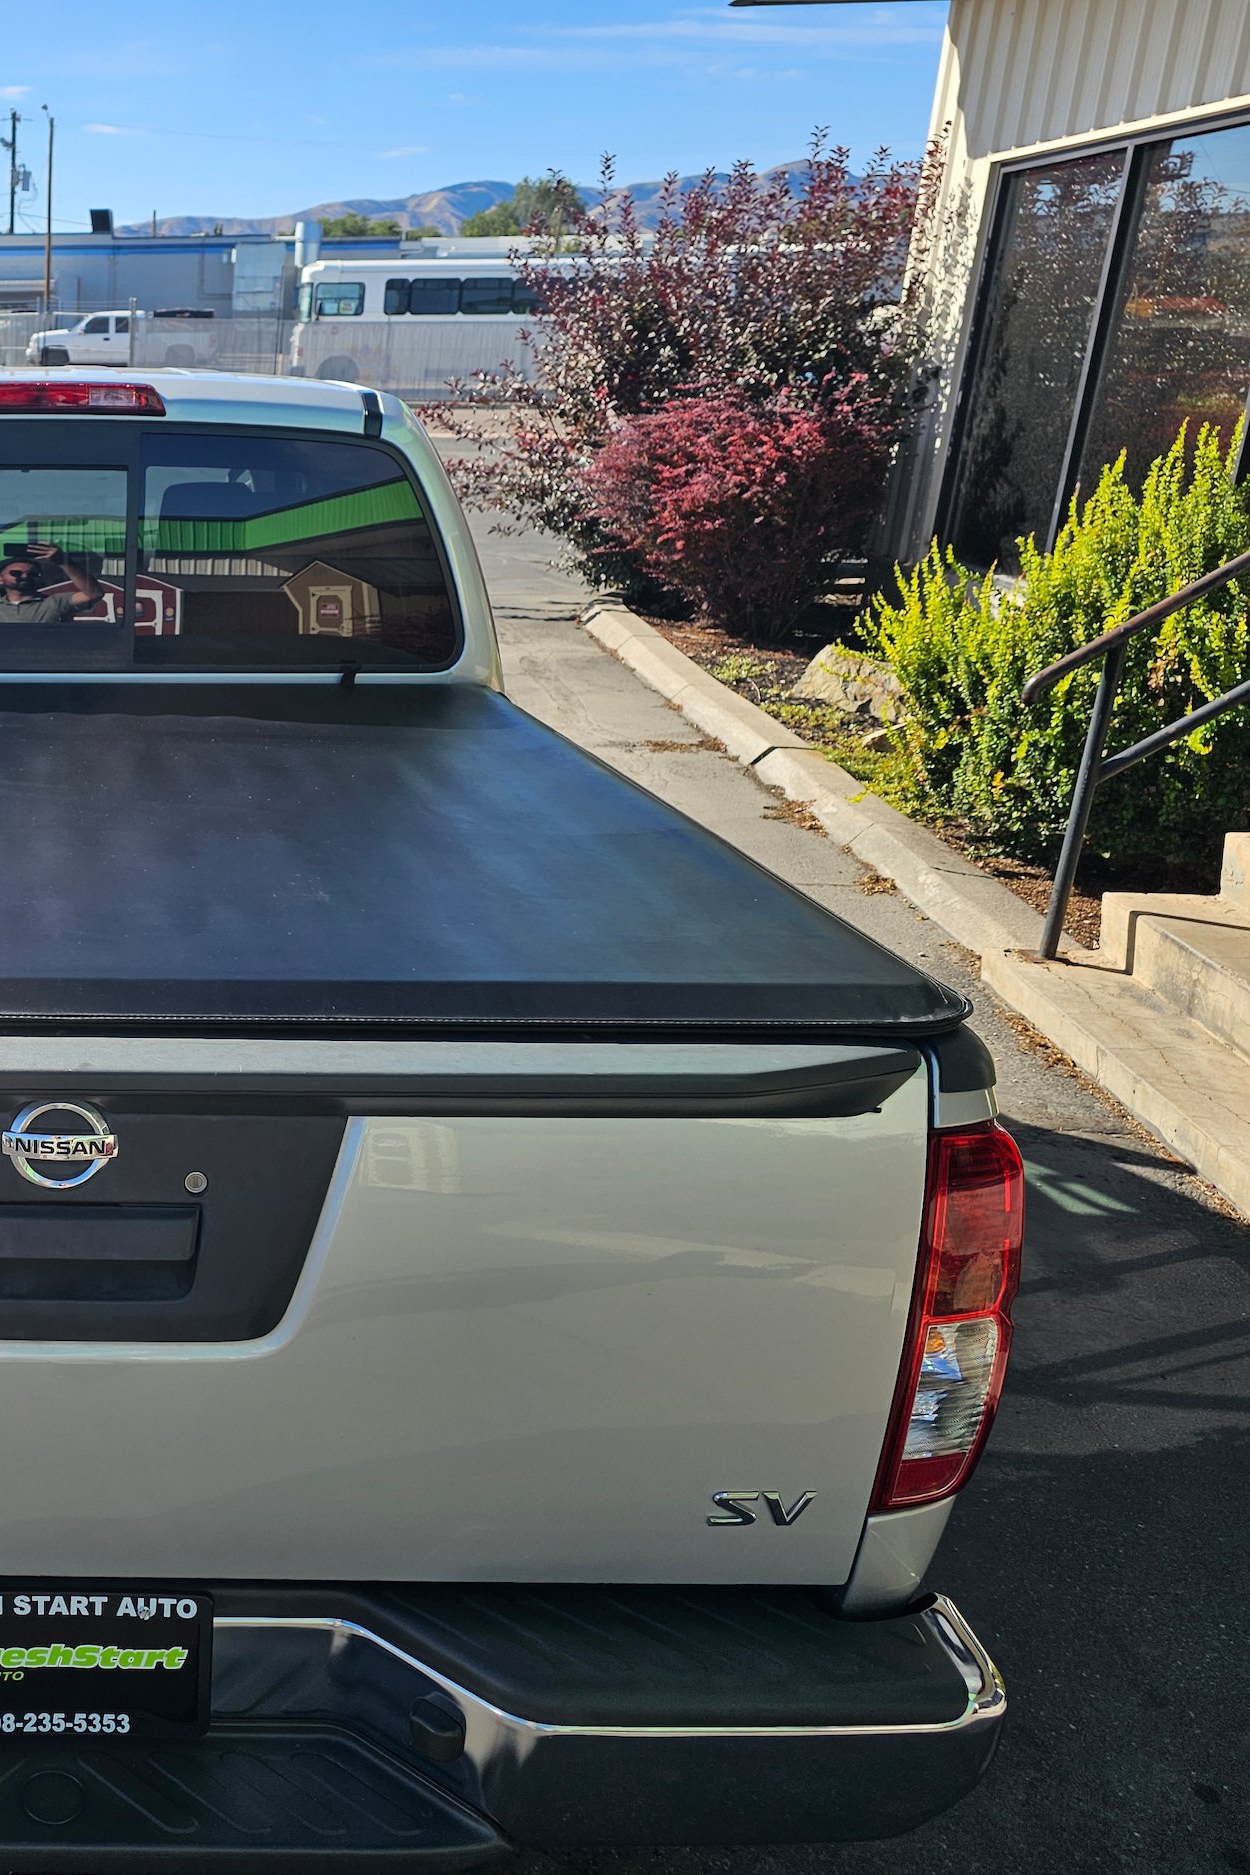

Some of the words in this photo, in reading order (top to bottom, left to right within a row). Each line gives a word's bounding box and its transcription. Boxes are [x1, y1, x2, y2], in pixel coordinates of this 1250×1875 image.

[14, 1137, 105, 1155] NISSAN
[705, 1490, 819, 1527] SV
[13, 1595, 108, 1616] START
[116, 1596, 198, 1619] AUTO
